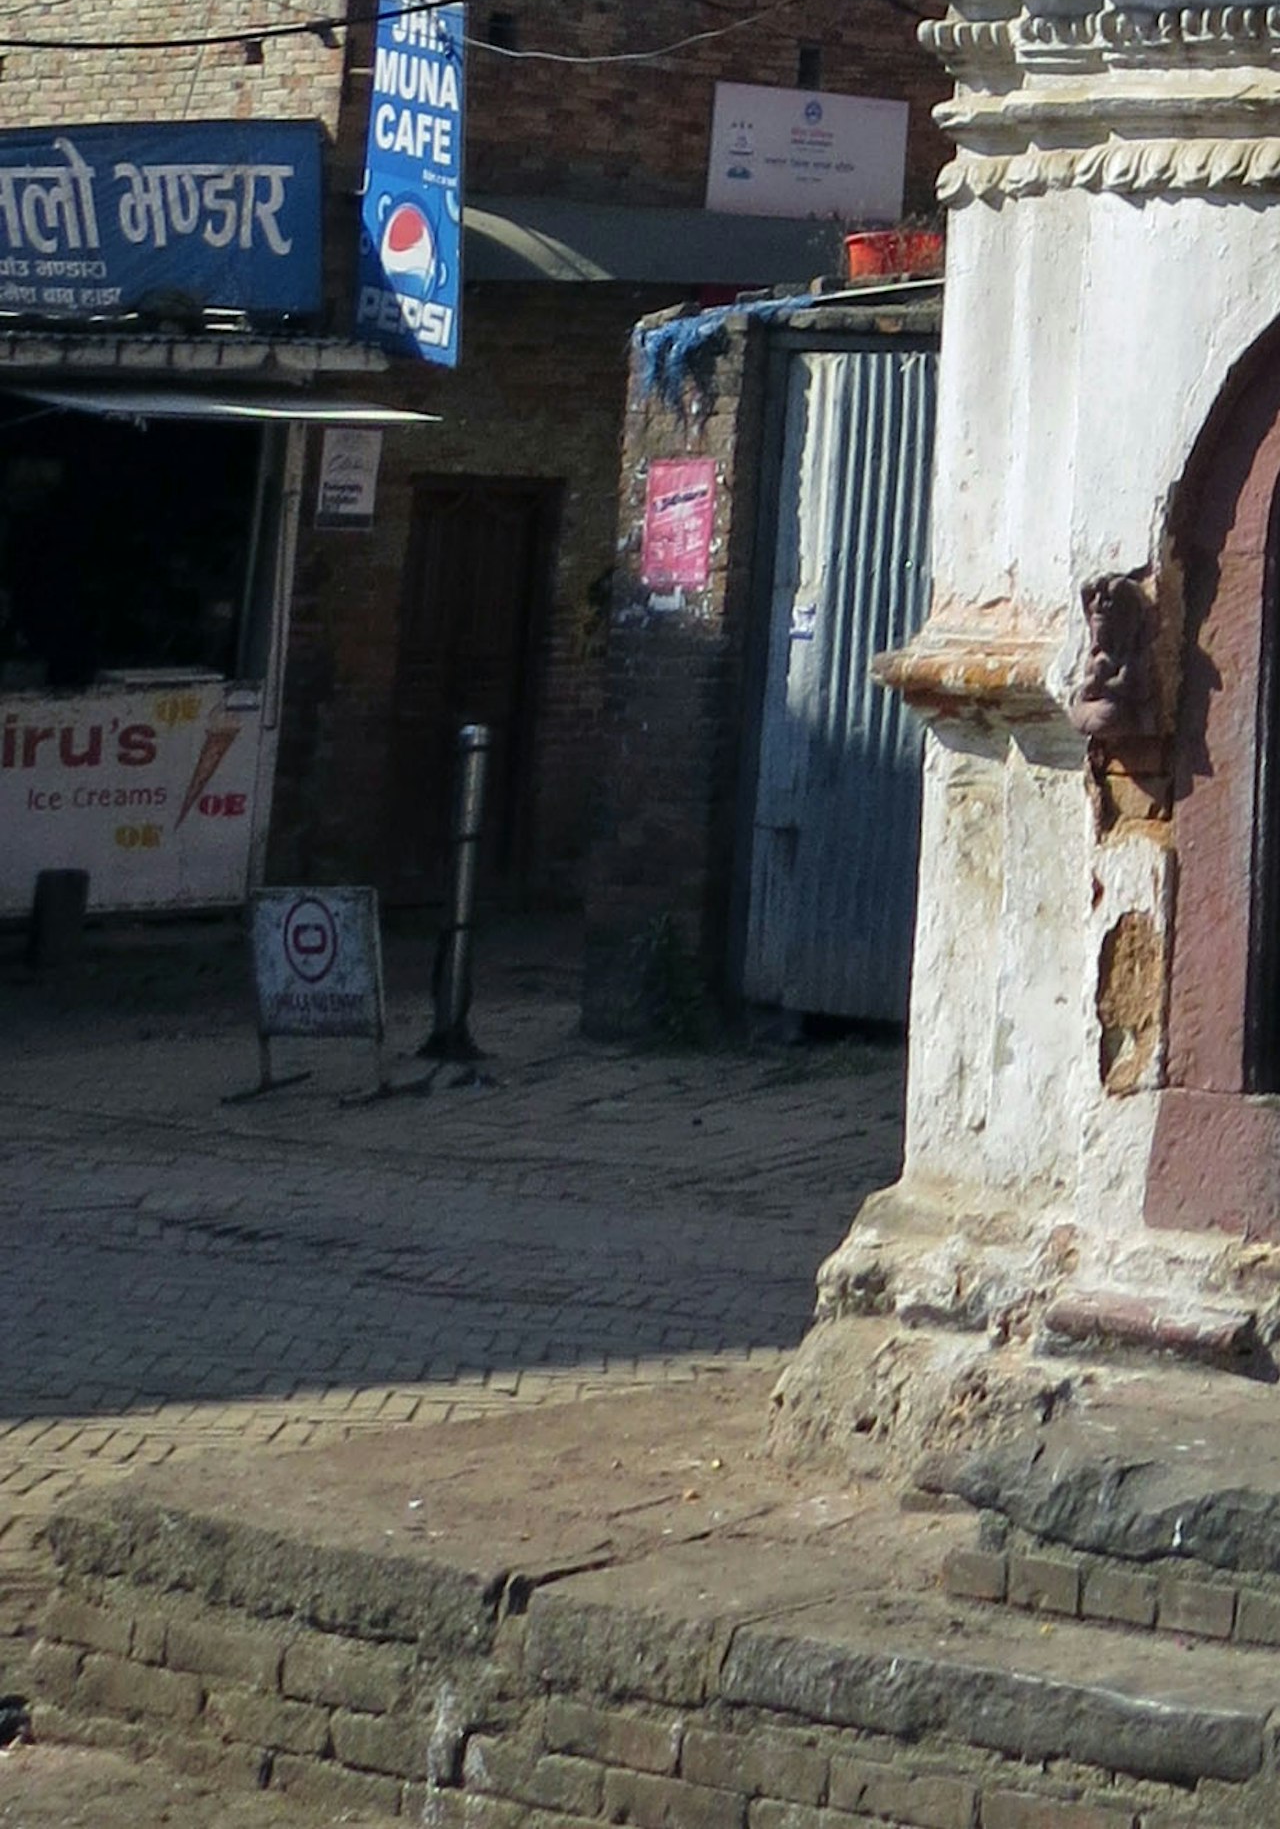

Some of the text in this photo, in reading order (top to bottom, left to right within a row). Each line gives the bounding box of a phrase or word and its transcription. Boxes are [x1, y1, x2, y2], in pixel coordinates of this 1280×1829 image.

[373, 48, 459, 112] MUNA
[375, 103, 452, 165] CAFE
[113, 161, 294, 255] भण्डार
[357, 286, 453, 348] PEPSI
[27, 787, 168, 811] Ice Creams
